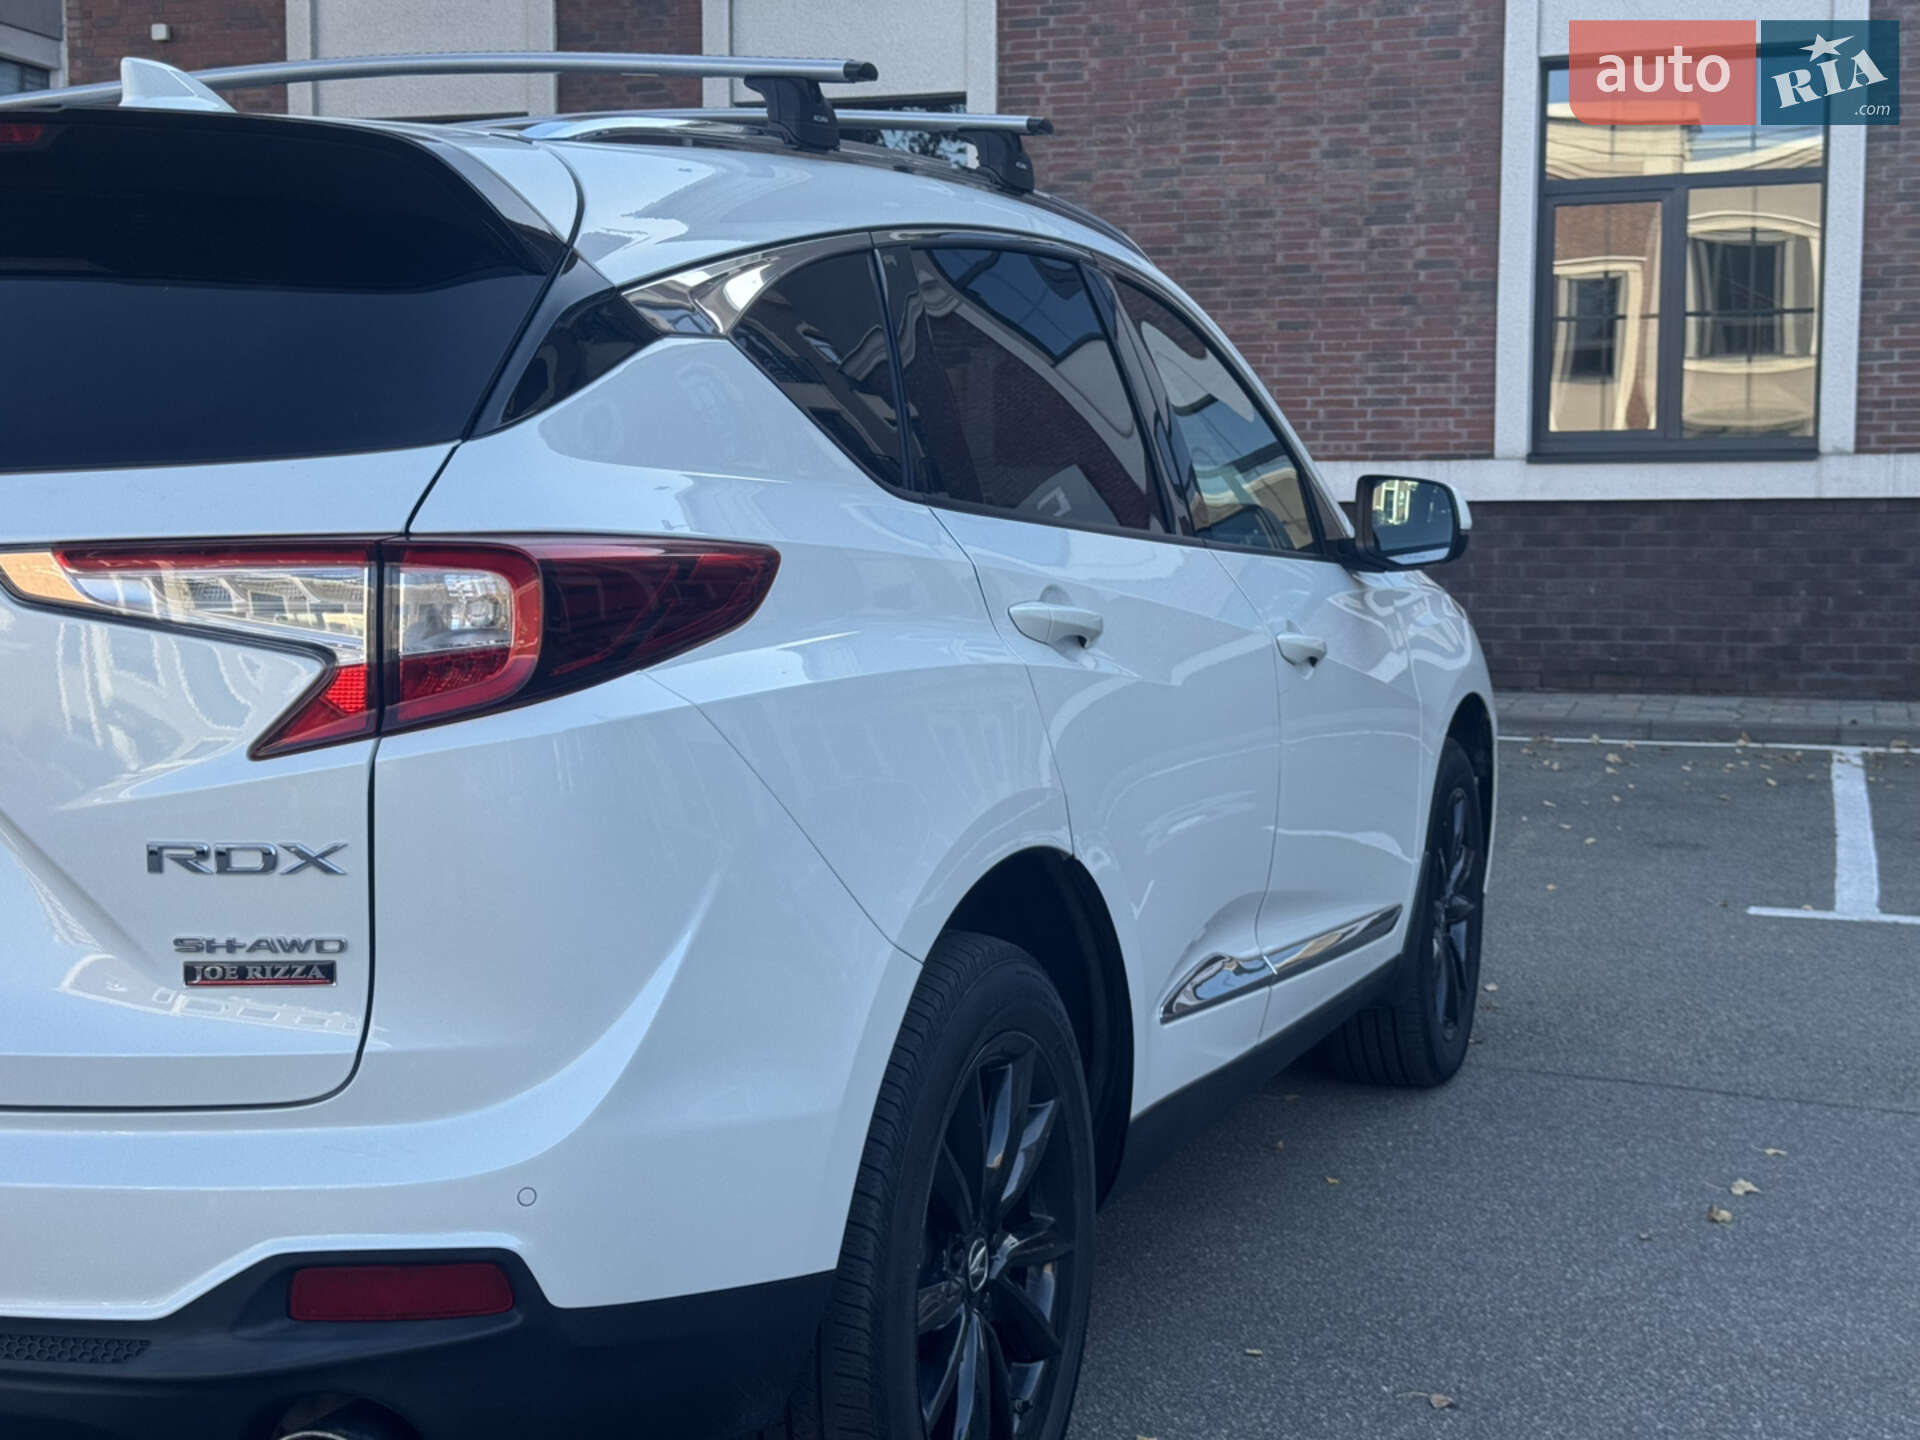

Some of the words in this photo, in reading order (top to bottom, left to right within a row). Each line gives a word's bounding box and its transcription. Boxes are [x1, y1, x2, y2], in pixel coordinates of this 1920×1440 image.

[146, 841, 349, 875] RDX
[192, 965, 239, 983] JOE
[246, 965, 326, 980] RIZZA
